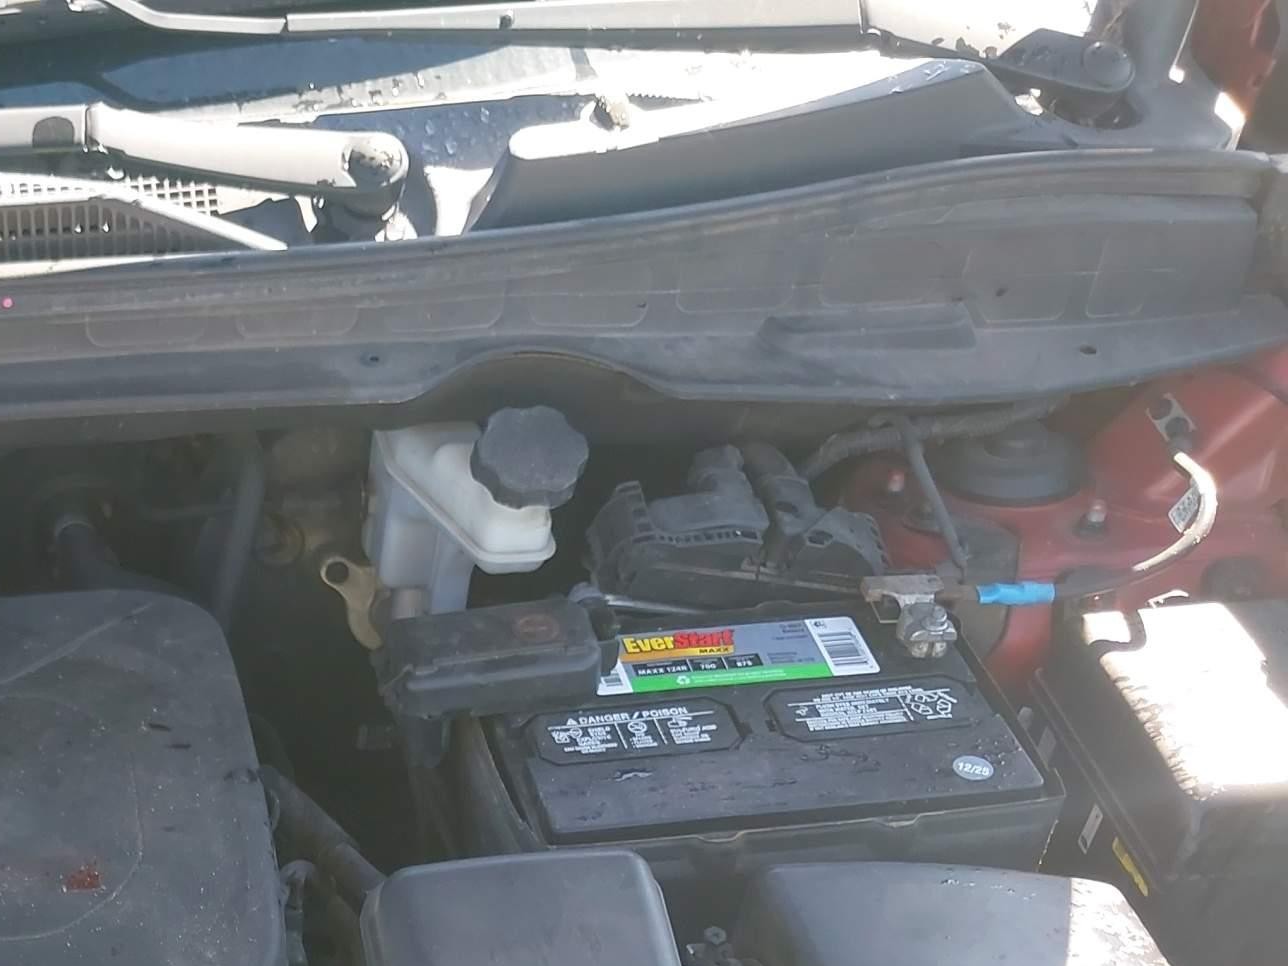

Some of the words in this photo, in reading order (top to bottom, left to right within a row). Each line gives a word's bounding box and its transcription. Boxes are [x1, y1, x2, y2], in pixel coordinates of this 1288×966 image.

[622, 629, 734, 654] EverStart
[699, 647, 729, 655] MAXX
[638, 667, 665, 676] MAXX
[579, 712, 630, 725] DANGER
[642, 706, 689, 718] POISON
